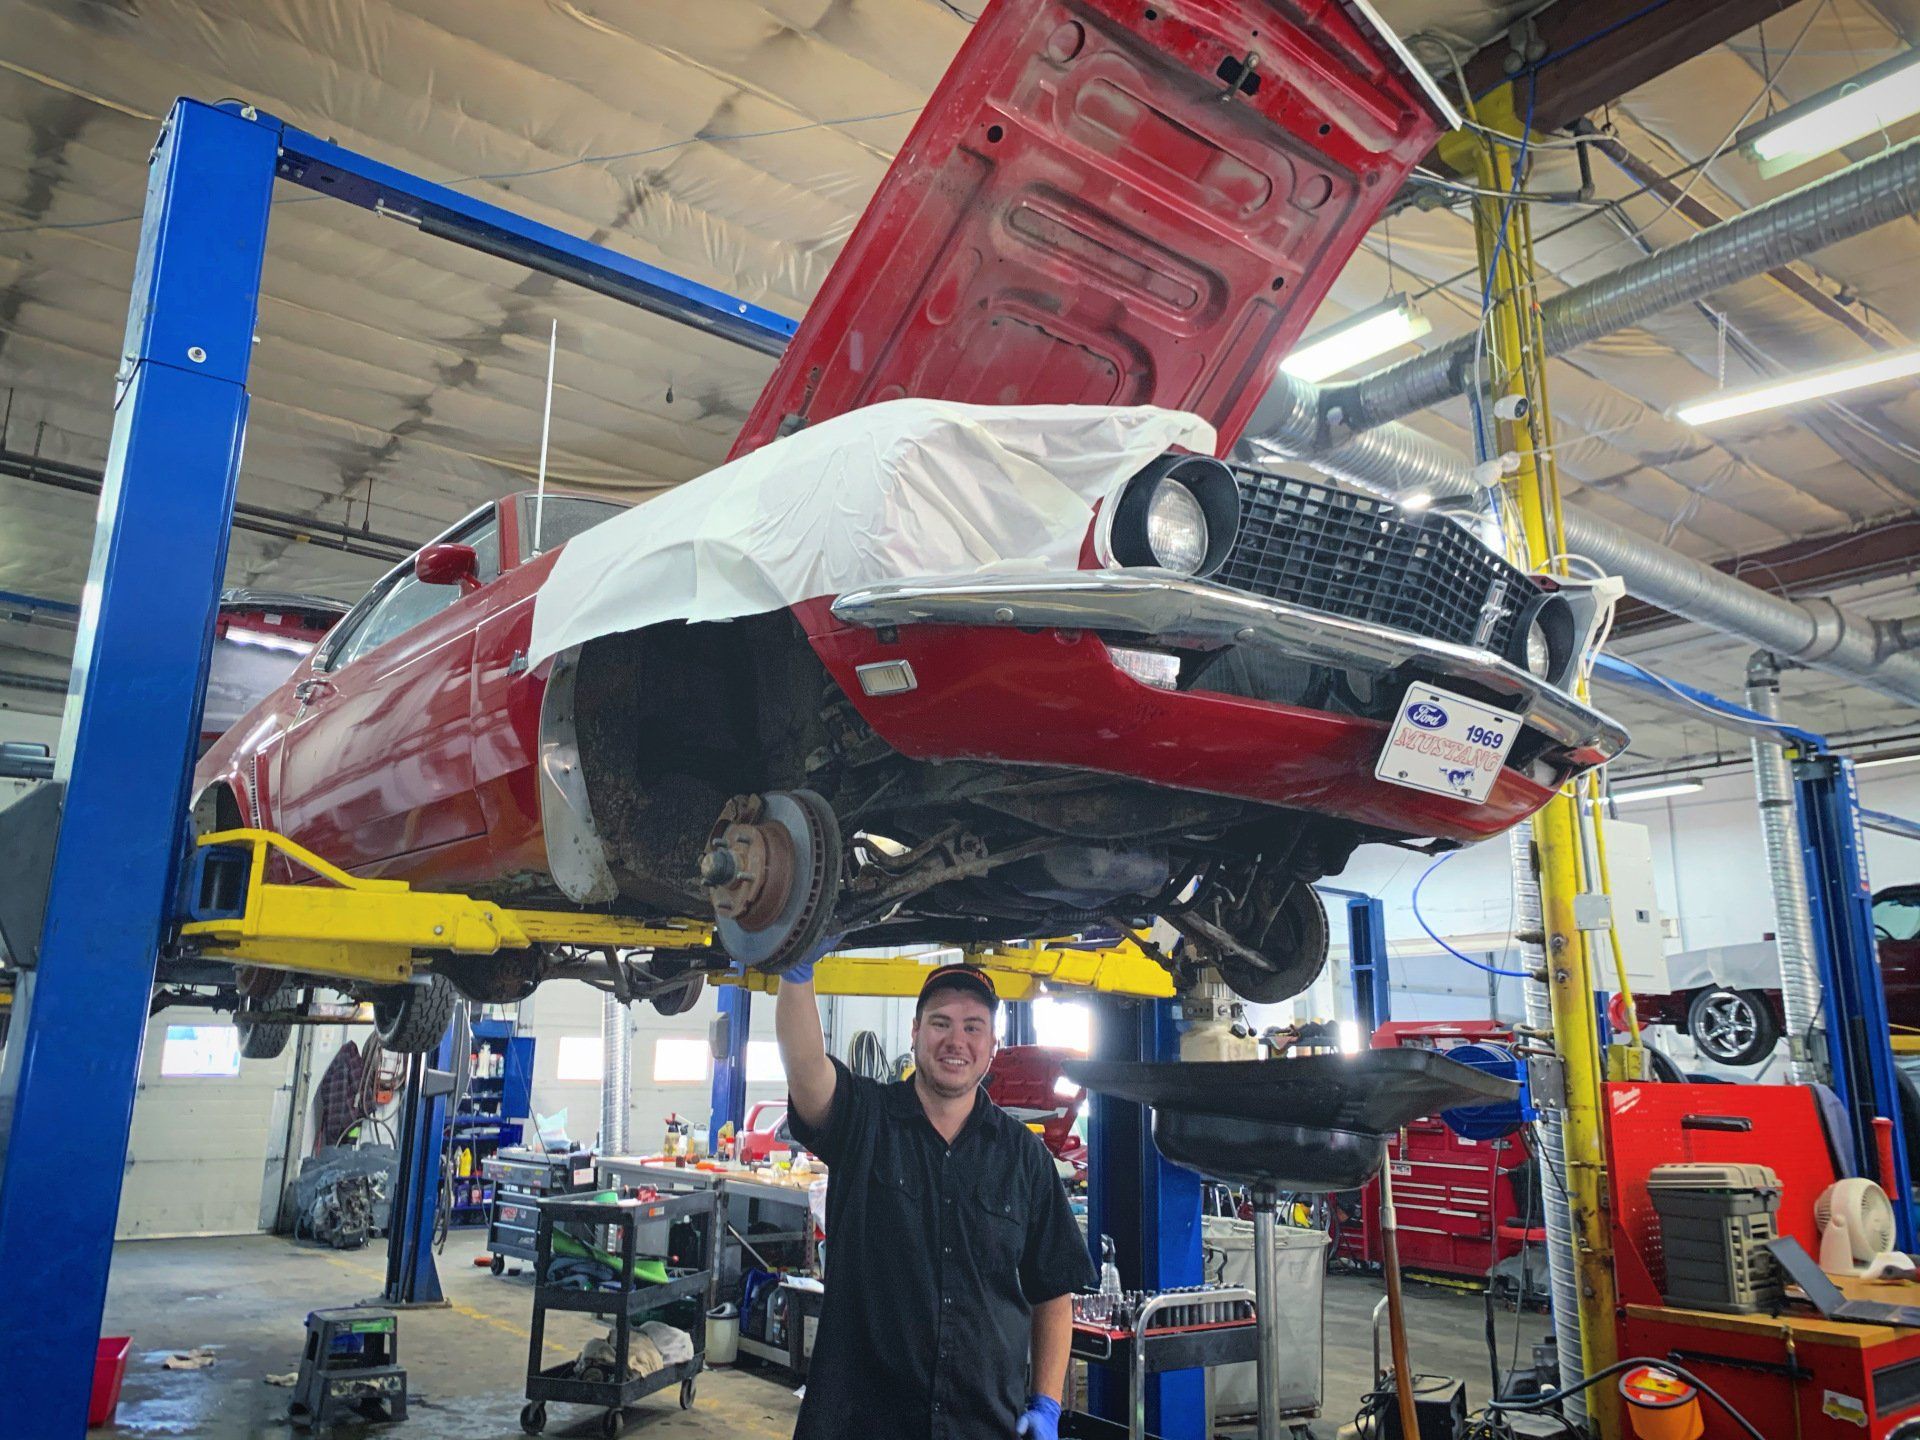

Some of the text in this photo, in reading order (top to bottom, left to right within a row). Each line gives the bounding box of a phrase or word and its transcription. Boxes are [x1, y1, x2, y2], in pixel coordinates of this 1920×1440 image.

[1413, 705, 1442, 726] Ford
[1466, 725, 1503, 749] 1969
[1394, 728, 1502, 772] MUSTANG
